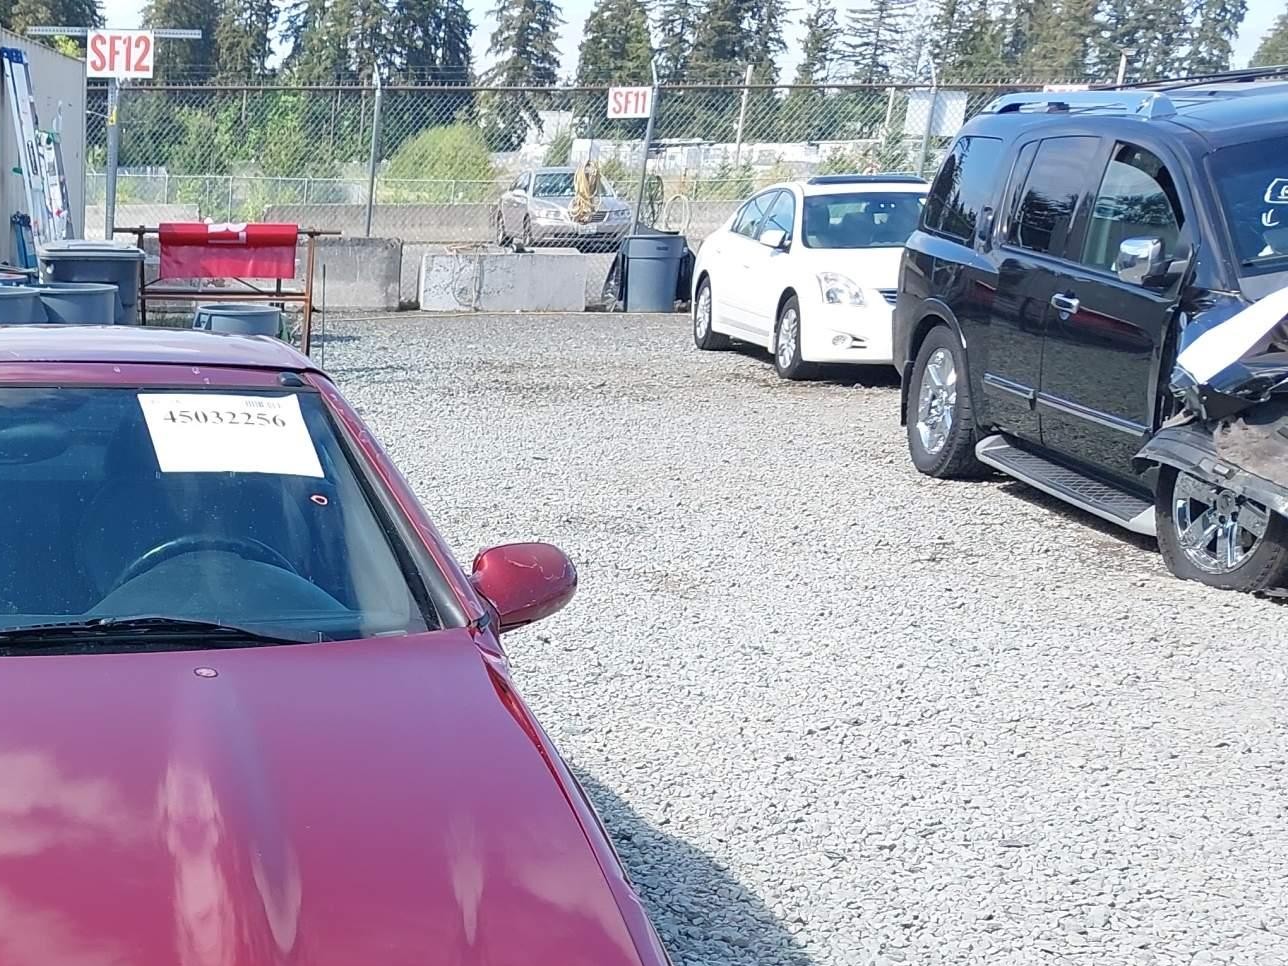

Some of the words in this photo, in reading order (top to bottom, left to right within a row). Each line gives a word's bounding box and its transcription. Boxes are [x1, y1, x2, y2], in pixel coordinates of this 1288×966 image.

[90, 33, 150, 72] SF12
[612, 90, 647, 114] SF11
[163, 410, 287, 427] 45032256
